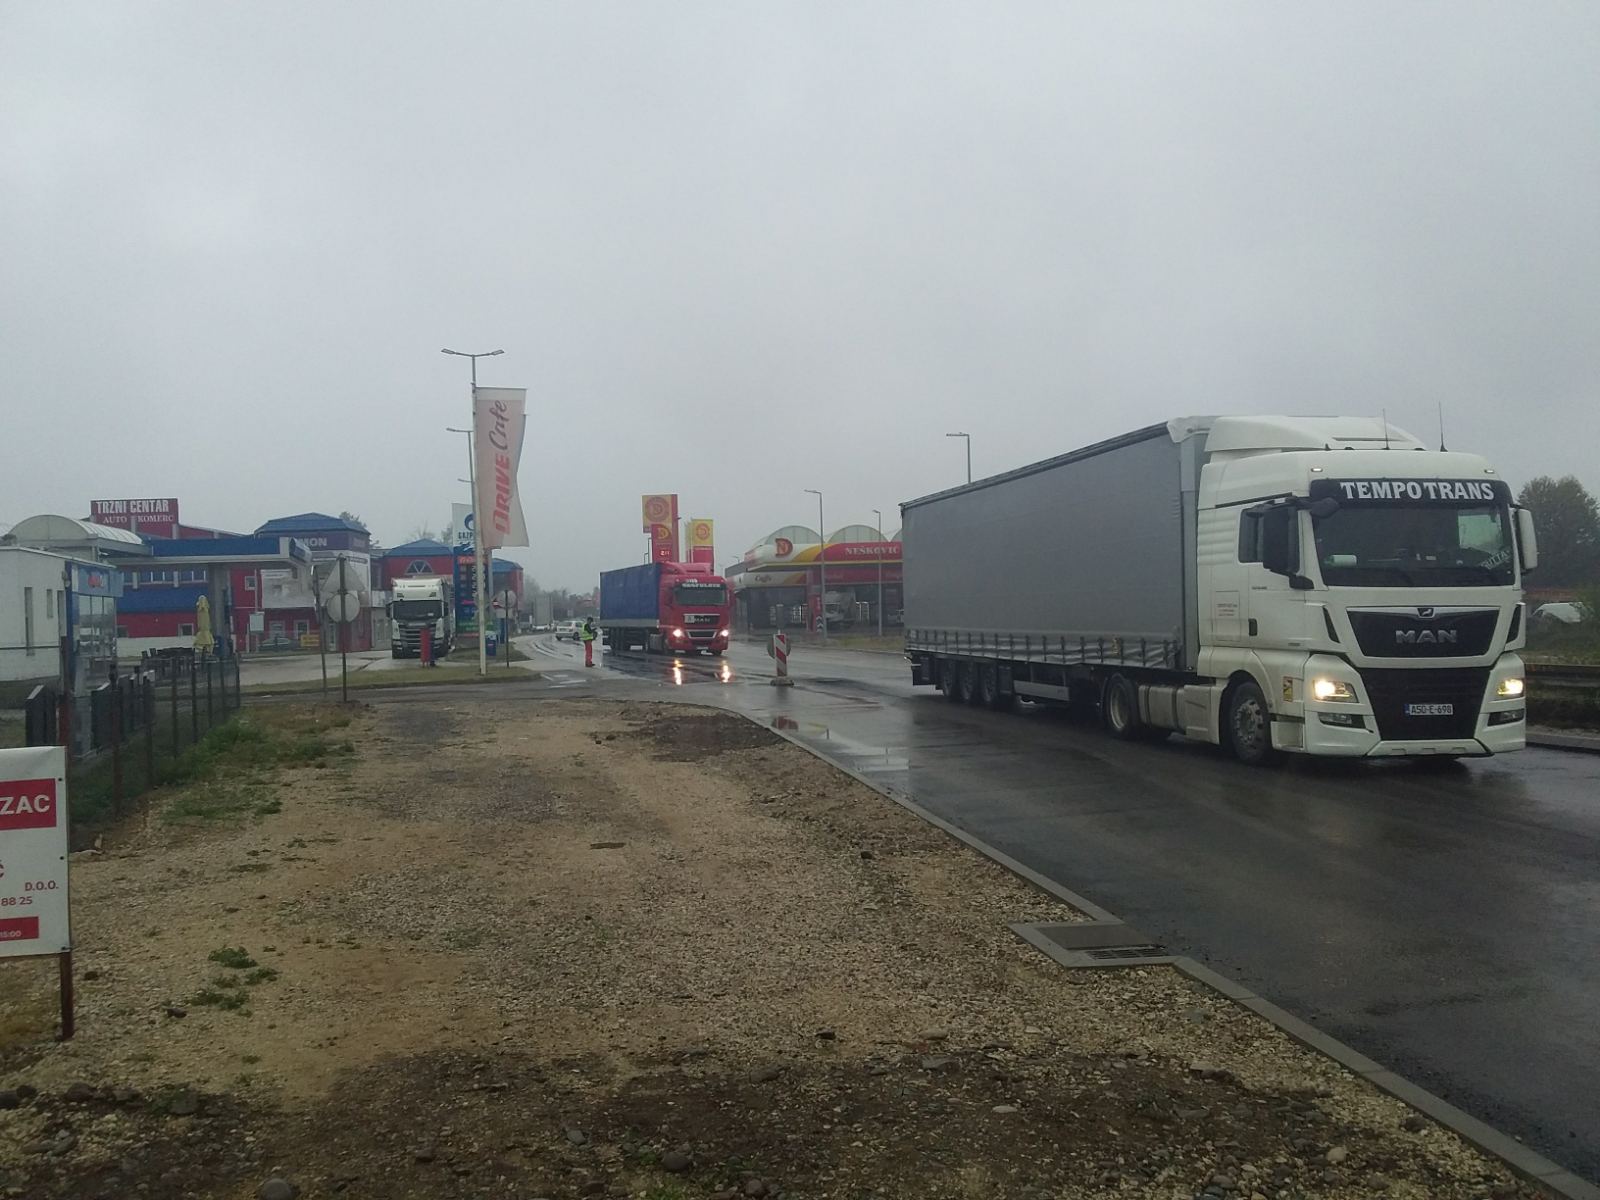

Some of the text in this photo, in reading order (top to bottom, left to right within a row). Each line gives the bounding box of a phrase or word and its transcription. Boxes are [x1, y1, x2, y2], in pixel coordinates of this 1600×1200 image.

[489, 399, 511, 535] DRIVE Cafe
[1340, 481, 1495, 501] TEMPO TRANS
[129, 500, 169, 512] CENTAR
[103, 514, 174, 524] AUTO KOMERC
[1395, 630, 1457, 644] MAN
[24, 880, 59, 891] D.O.O.
[19, 896, 33, 905] 25
